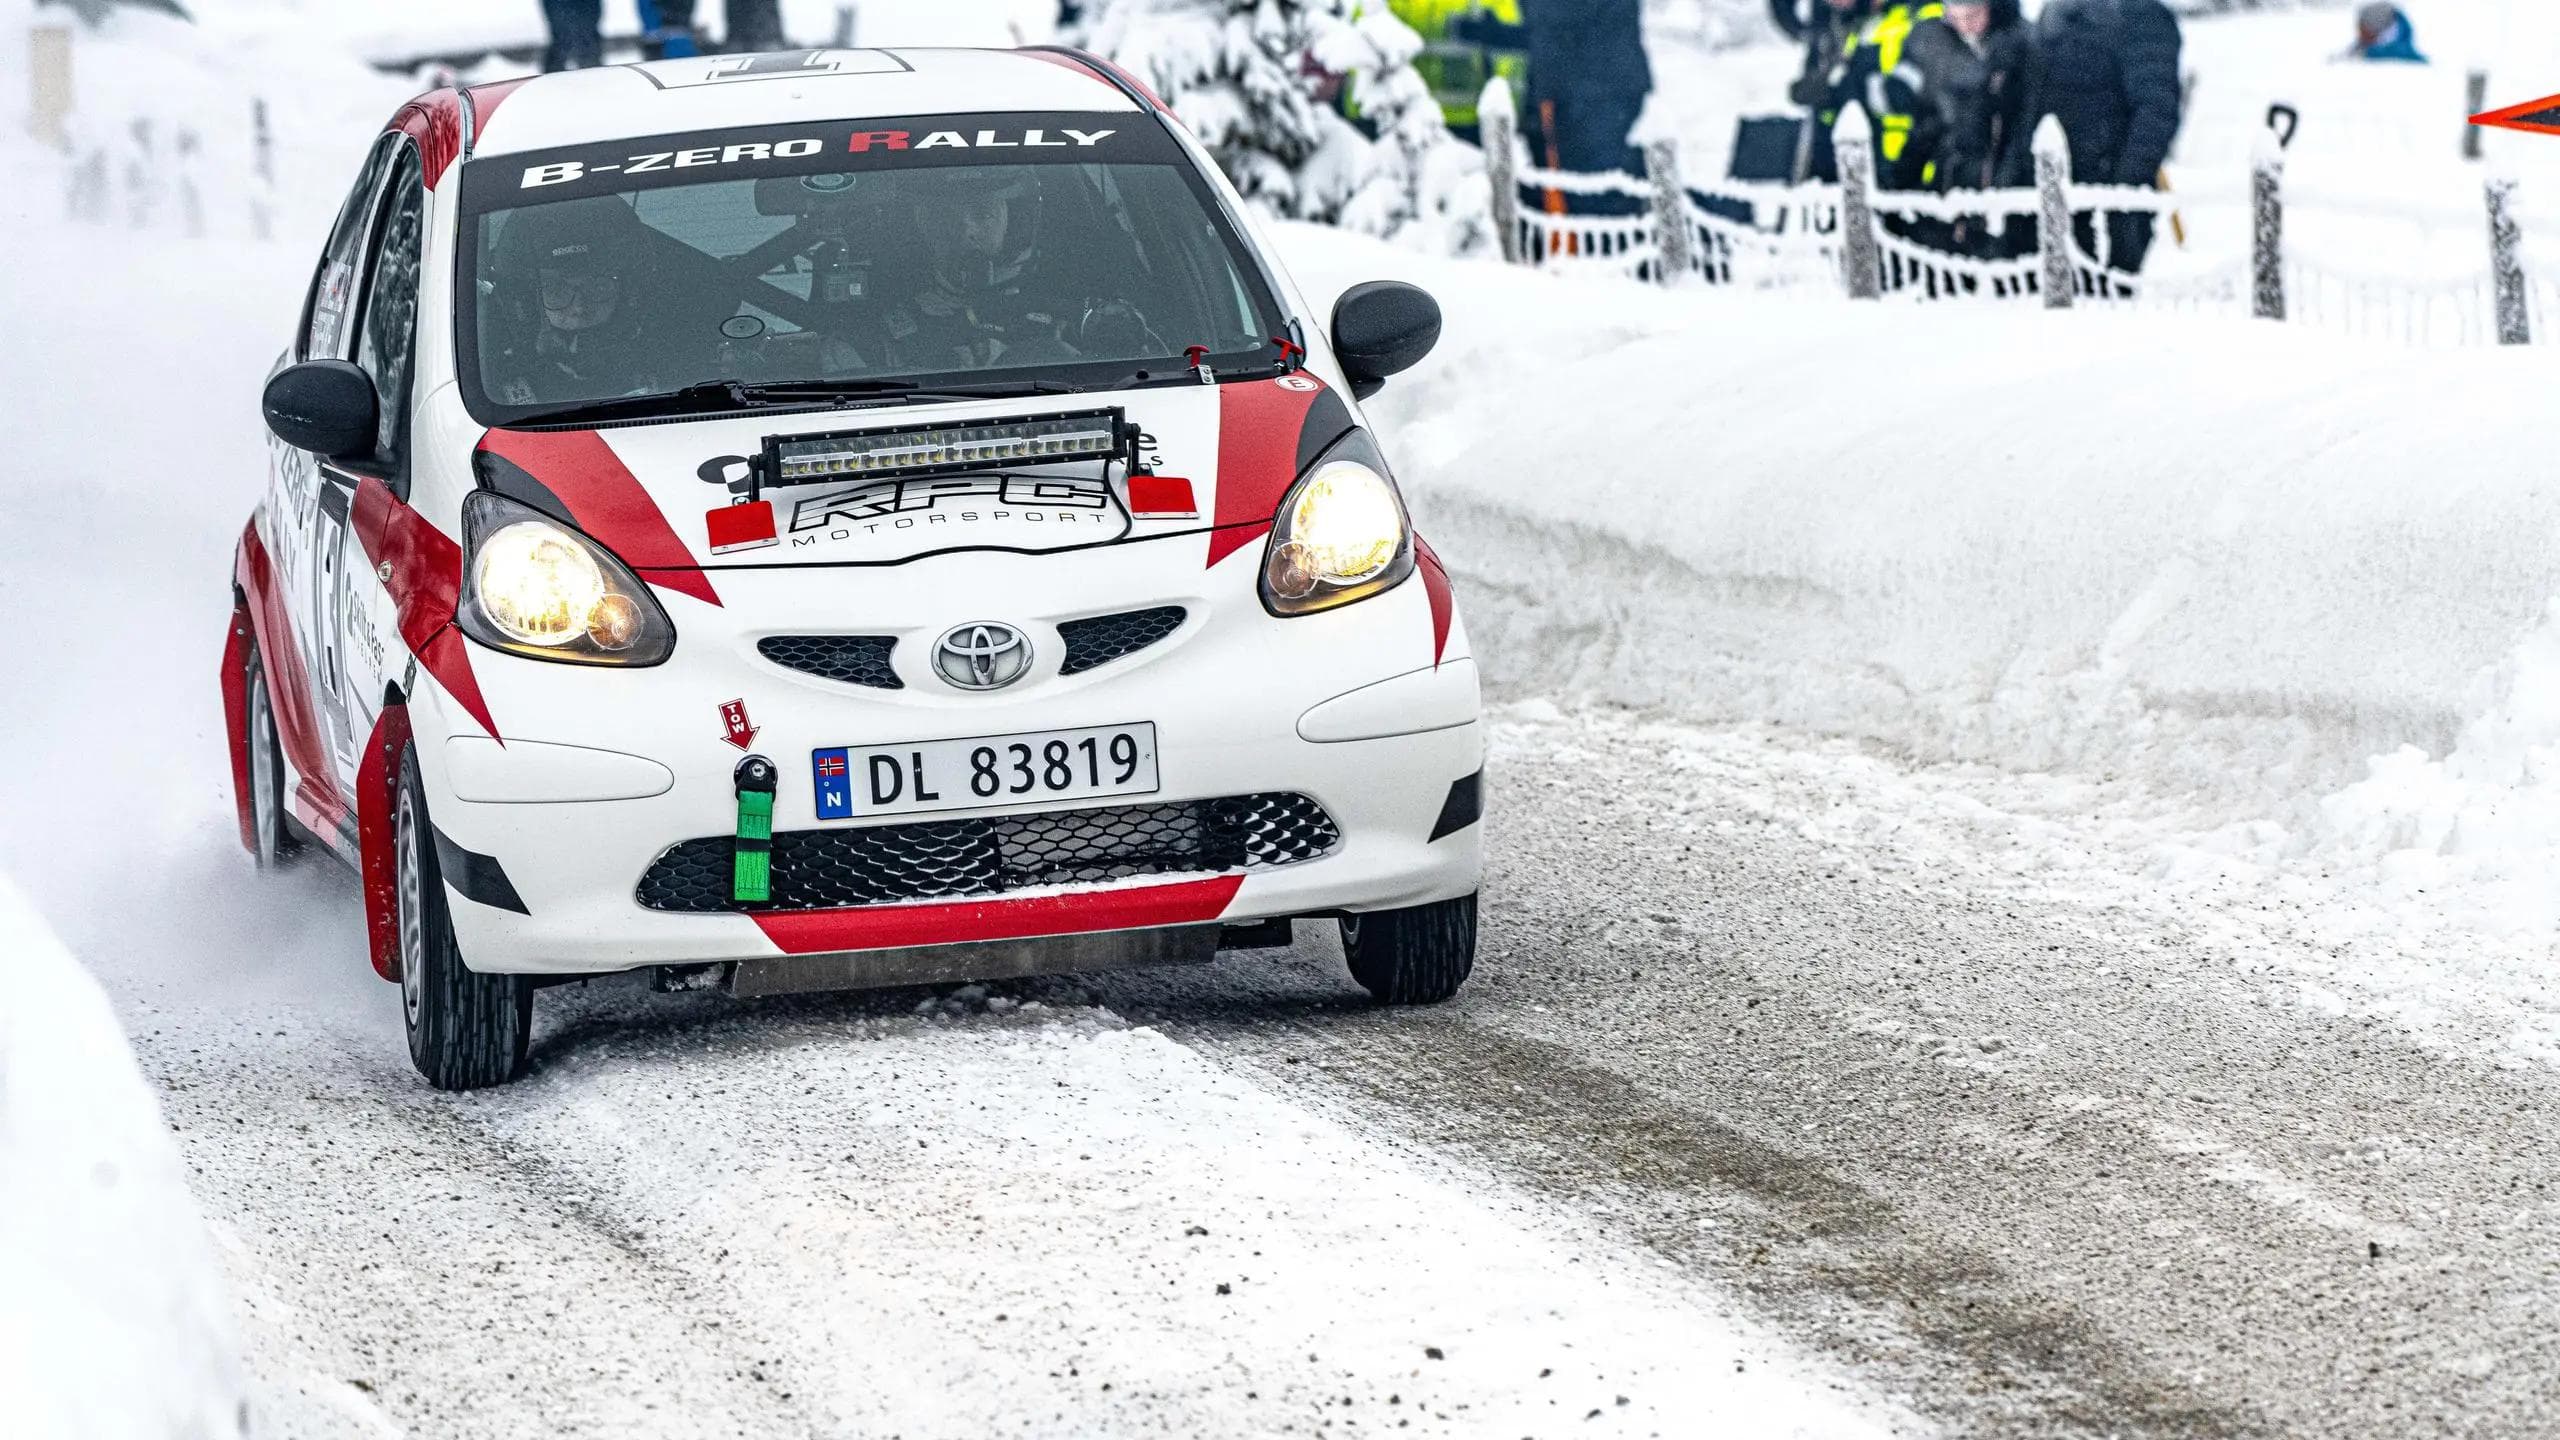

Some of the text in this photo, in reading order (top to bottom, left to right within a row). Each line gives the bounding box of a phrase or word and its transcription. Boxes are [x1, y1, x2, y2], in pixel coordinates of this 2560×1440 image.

[520, 129, 1117, 189] B-ZERO RALLY
[791, 511, 1105, 548] MOTORSPORT
[727, 704, 745, 734] TOW
[868, 733, 1139, 805] DL 83819
[826, 791, 842, 807] N
